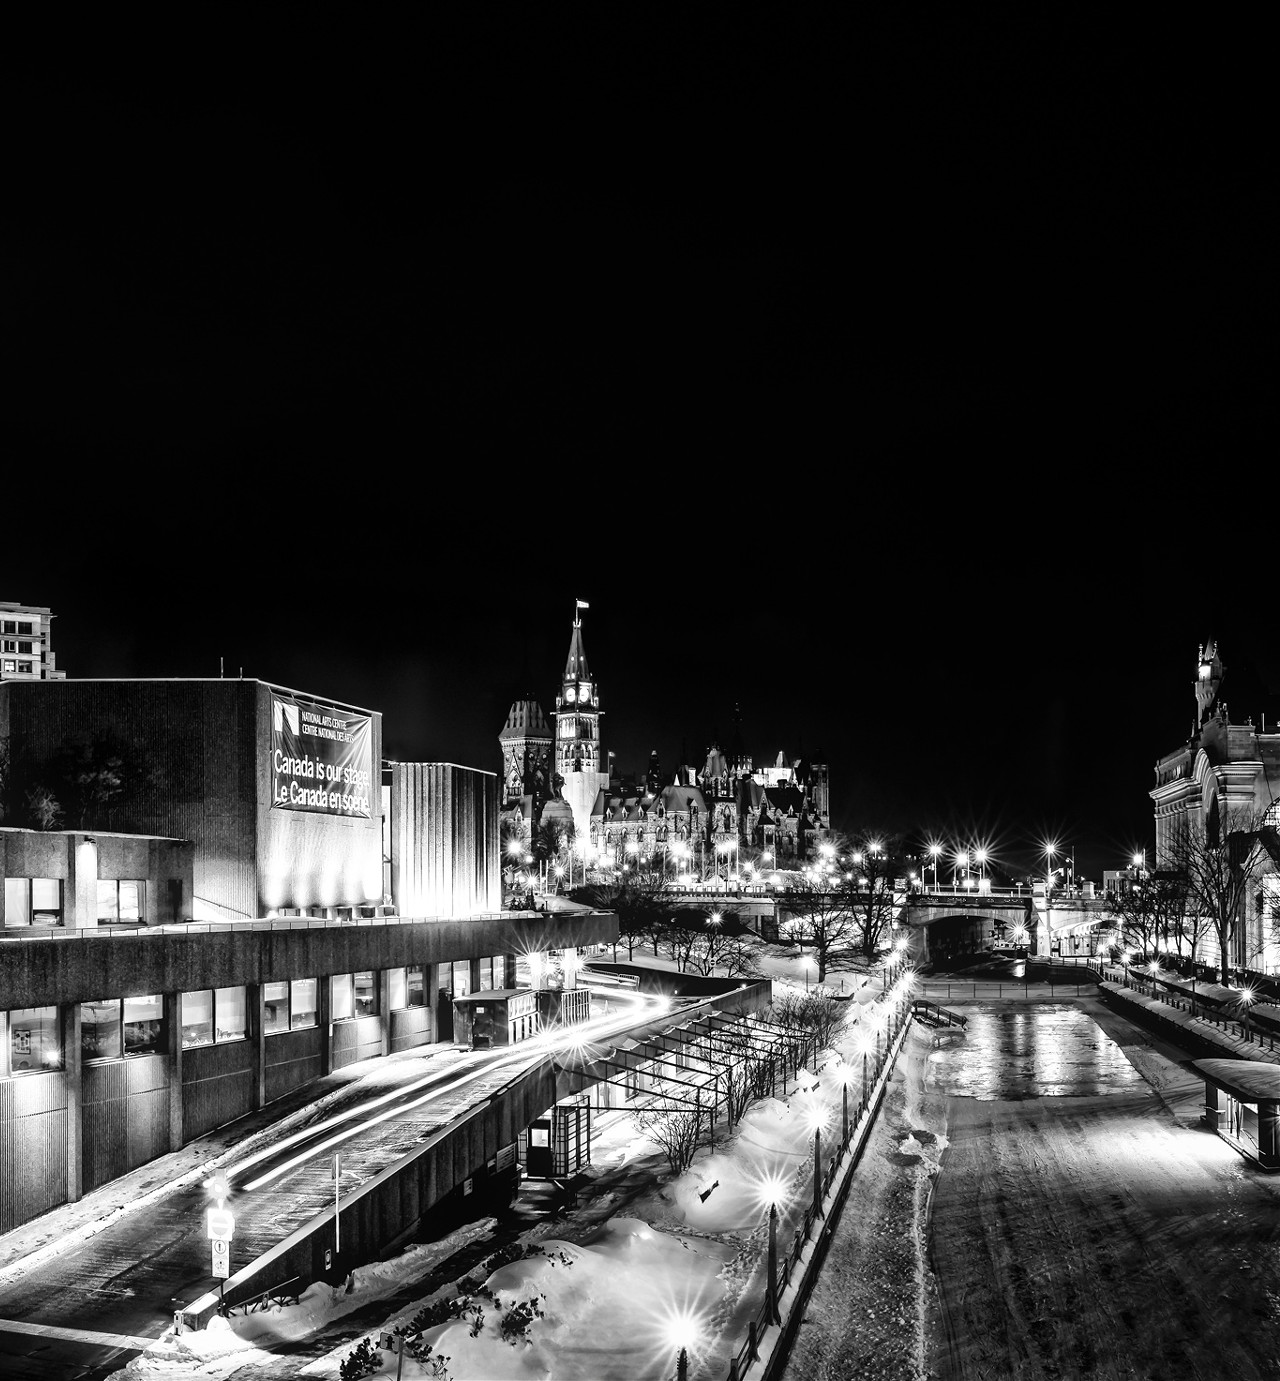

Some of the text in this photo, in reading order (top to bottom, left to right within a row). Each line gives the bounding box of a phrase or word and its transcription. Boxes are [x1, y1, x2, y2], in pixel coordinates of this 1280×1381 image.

[302, 711, 321, 725] NATIONAL
[322, 715, 332, 727] ARTS
[302, 724, 318, 736] CENTRE
[318, 726, 336, 740] NATIONAL
[275, 749, 314, 778] Canada
[316, 757, 324, 780] is
[326, 764, 341, 782] our
[275, 778, 287, 802] Le
[290, 781, 327, 807] Canada
[330, 792, 341, 809] en
